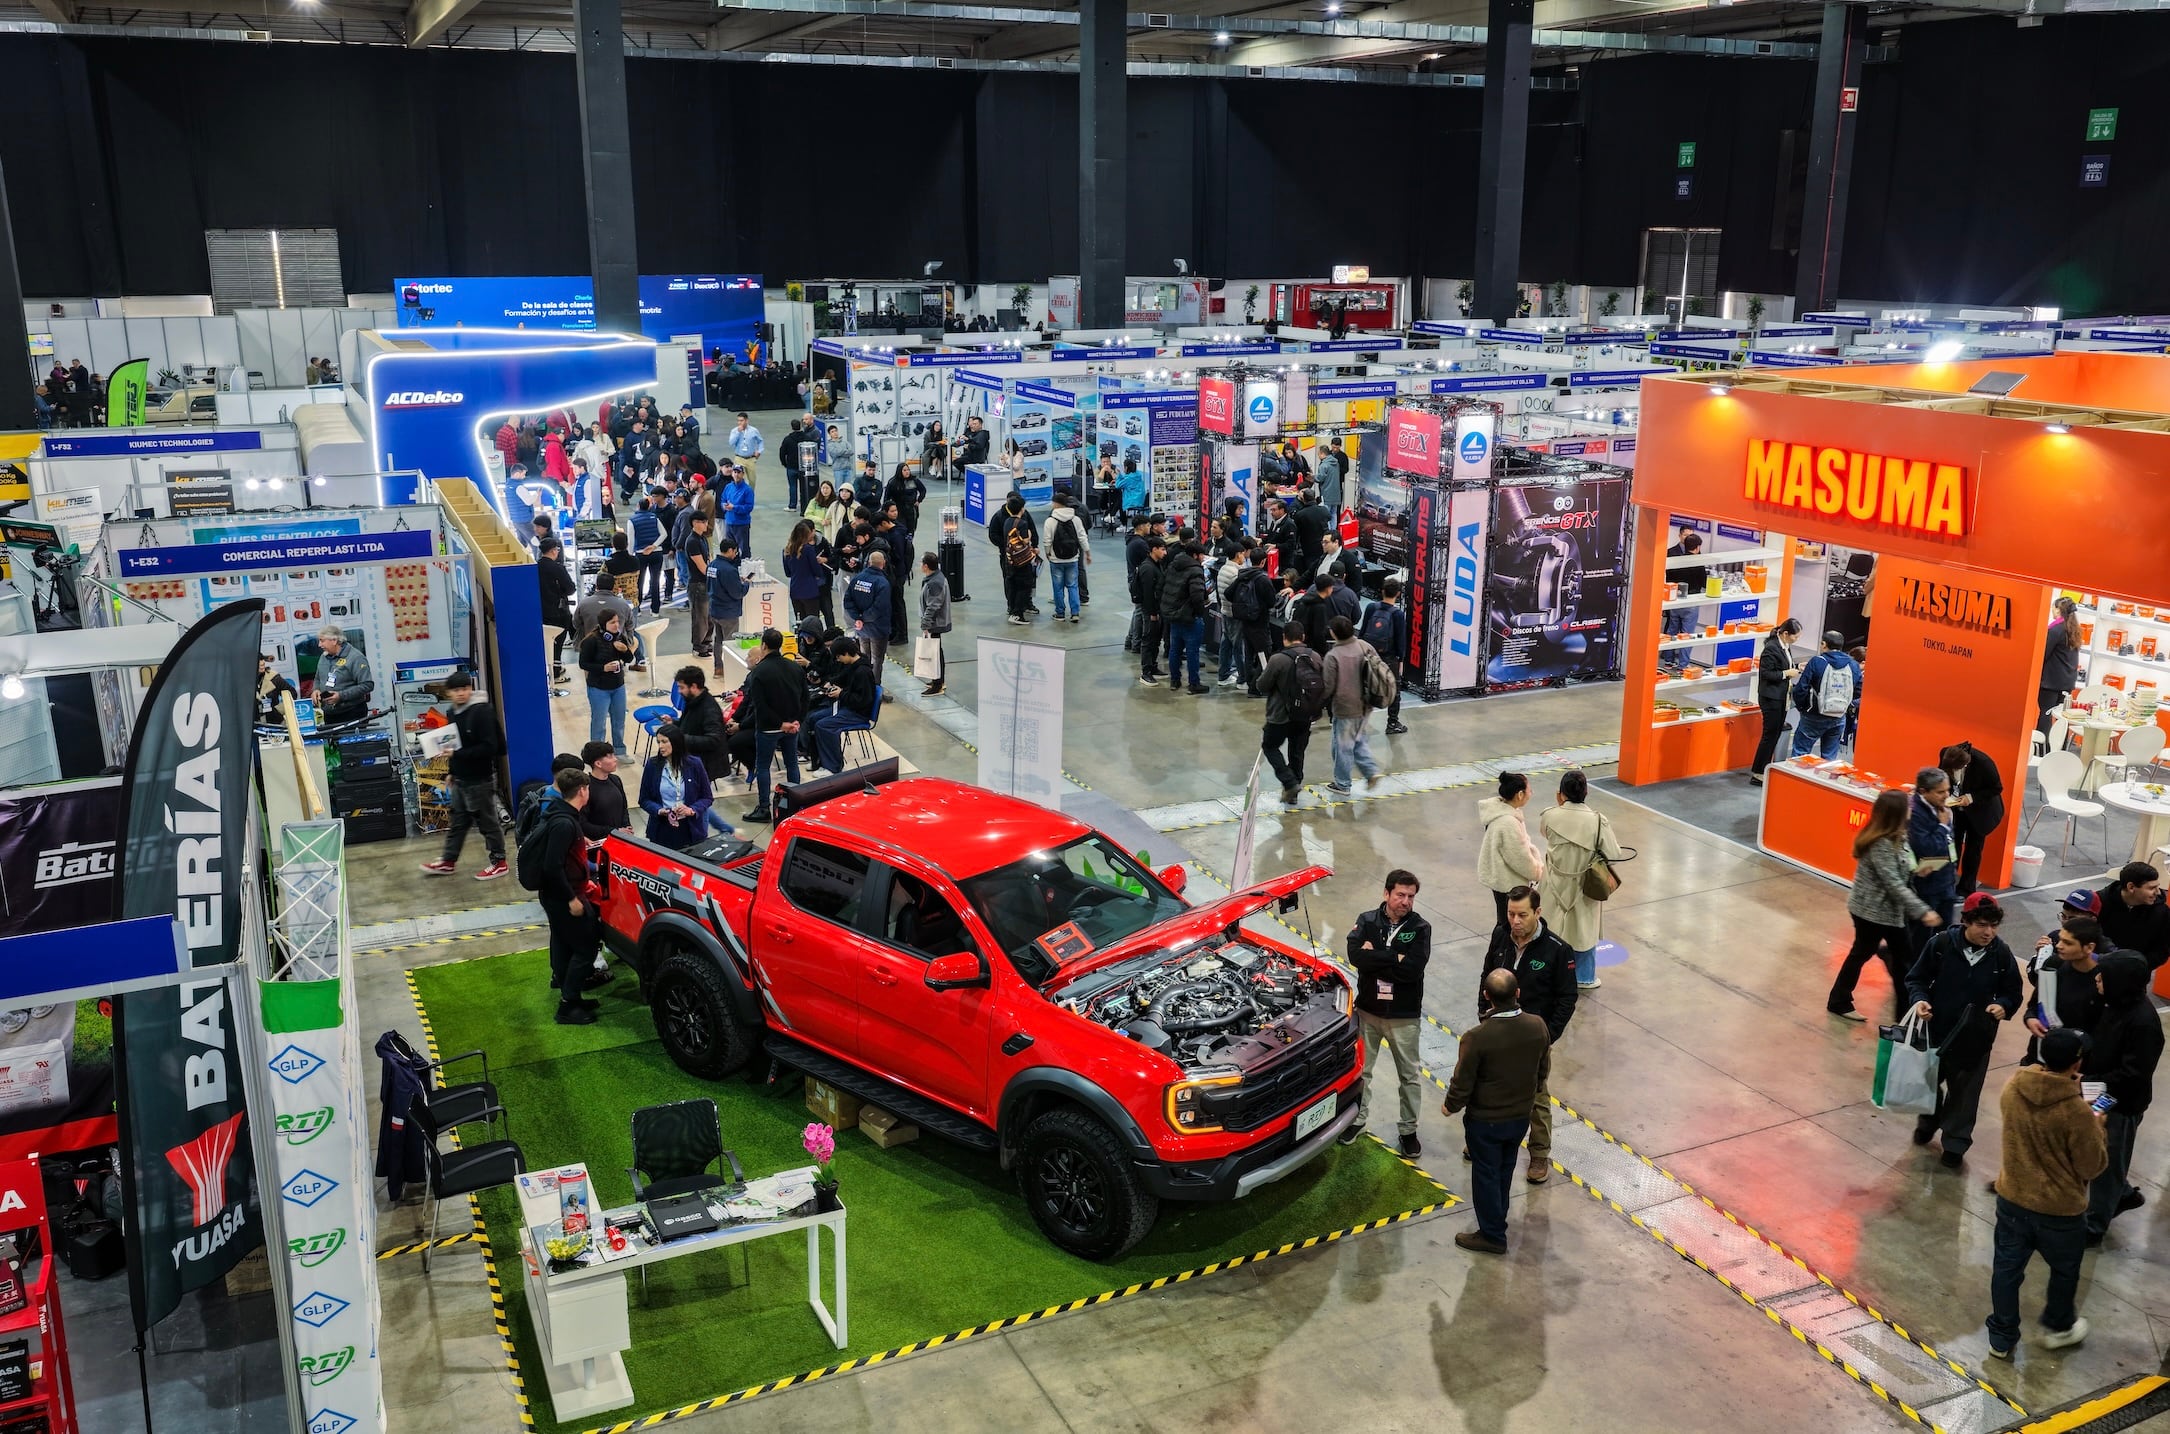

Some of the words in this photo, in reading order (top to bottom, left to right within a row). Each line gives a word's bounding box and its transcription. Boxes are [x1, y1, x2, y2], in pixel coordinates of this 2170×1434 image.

[504, 309, 541, 318] Formación
[548, 308, 577, 317] desafíos
[588, 308, 594, 316] la
[559, 301, 569, 309] de
[386, 391, 463, 405] ACDelco
[1204, 396, 1226, 415] GTX
[129, 440, 158, 449] KIUMEC
[158, 438, 215, 448] TECHNOLOGIES
[1398, 430, 1429, 453] GTX
[1745, 439, 1965, 536] MASUMA
[1524, 515, 1560, 526] FRENOS
[1560, 511, 1599, 529] GTX
[1415, 495, 1431, 584] DRUMS
[129, 557, 159, 567] 1-E32
[223, 549, 285, 562] COMERCIAL
[286, 545, 355, 558] REPERPLAST
[356, 542, 385, 554] LTDA
[1451, 522, 1480, 656] LUDA
[760, 591, 775, 629] bpro
[1898, 576, 2009, 630] MASUMA
[1409, 585, 1425, 669] BRAKE
[1512, 627, 1532, 635] Discos
[1533, 626, 1542, 634] de
[1542, 624, 1559, 633] freno
[1922, 638, 1947, 654] TOKYO,
[1948, 644, 1973, 658] JAPAN
[610, 861, 671, 907] RAPTOR
[164, 692, 227, 1111] BATERÍAS
[280, 1059, 309, 1072] GLP
[292, 1182, 322, 1195] GLP
[171, 1203, 246, 1270] YUASA
[302, 1303, 333, 1317] GLP
[312, 1420, 341, 1434] GLP
